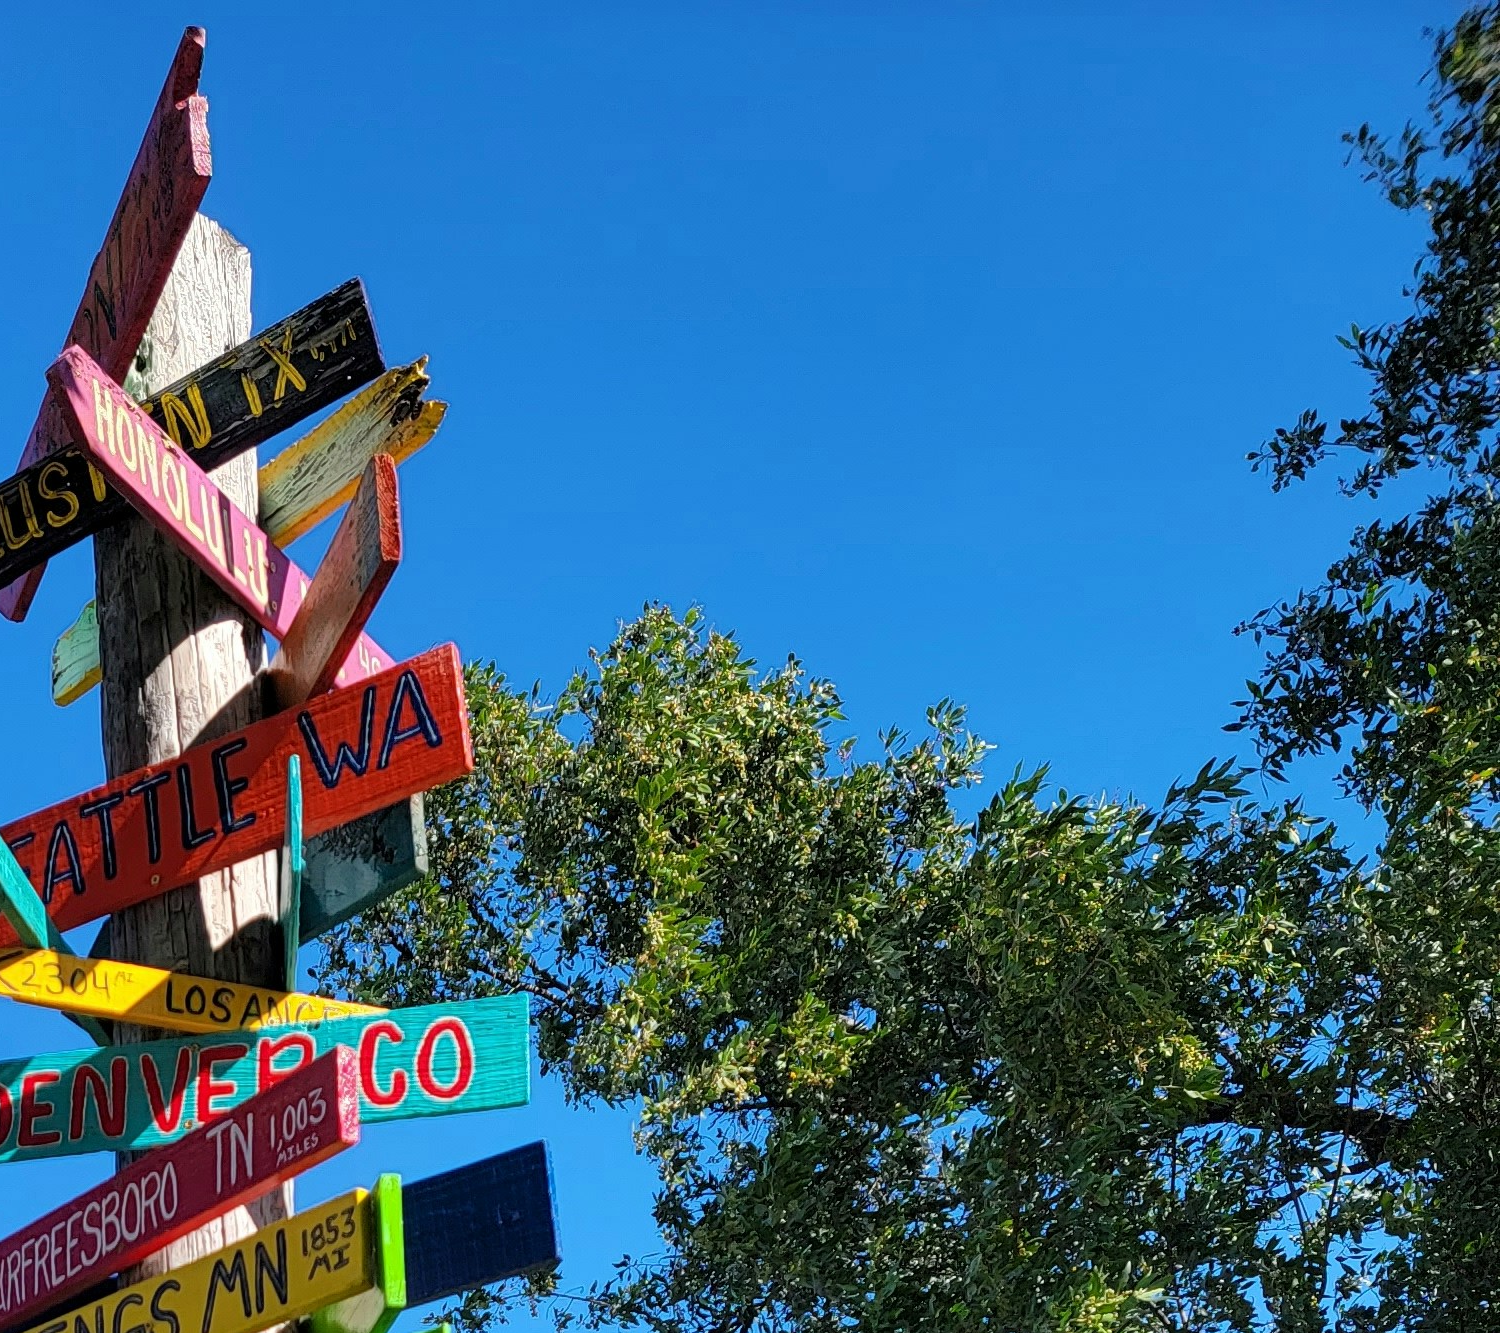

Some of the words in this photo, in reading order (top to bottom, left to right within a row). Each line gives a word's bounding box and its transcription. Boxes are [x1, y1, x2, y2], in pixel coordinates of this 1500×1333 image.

[300, 667, 443, 789] WA
[166, 979, 236, 1023] LOS
[358, 1015, 475, 1106] CO
[206, 1112, 254, 1195] TN
[276, 1132, 319, 1169] MILES
[308, 1243, 351, 1281] MI
